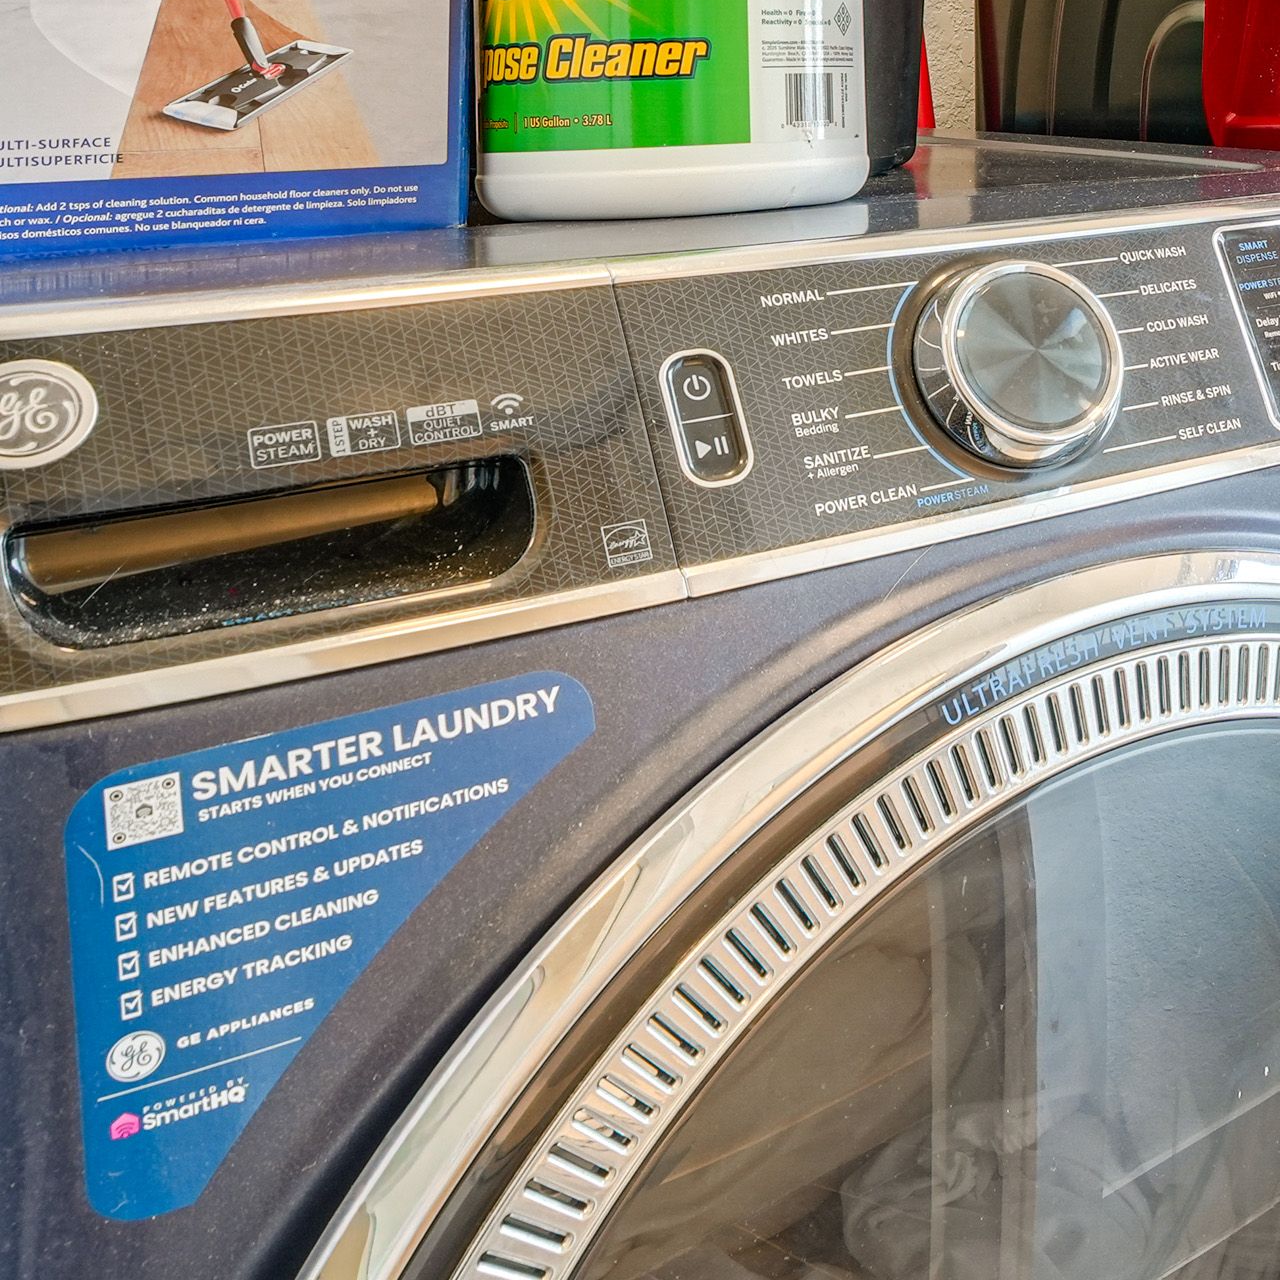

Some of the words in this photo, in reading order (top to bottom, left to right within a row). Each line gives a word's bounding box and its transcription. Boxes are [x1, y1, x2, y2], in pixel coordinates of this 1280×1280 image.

[544, 37, 710, 81] Cleaner
[530, 117, 540, 128] US
[542, 116, 570, 127] Gallon
[582, 115, 604, 126] 3.78
[606, 114, 612, 125] L
[35, 203, 56, 212] Add
[59, 201, 67, 210] 2
[69, 202, 91, 213] tsps
[92, 199, 104, 209] of
[105, 197, 146, 210] cleaning
[149, 196, 191, 206] solution.
[193, 194, 238, 204] Common
[240, 191, 287, 201] household
[289, 189, 310, 199] floor
[312, 188, 349, 198] cleaners
[350, 186, 372, 197] only.
[373, 186, 386, 195] Do
[387, 185, 402, 194] not
[403, 184, 419, 193] use
[1238, 239, 1268, 251] SMART
[1120, 248, 1154, 265] QUICK
[1154, 246, 1186, 261] WASH
[1236, 250, 1279, 265] DISPENSE
[1140, 278, 1197, 296] DELICATES
[760, 288, 825, 308] NORMAL
[1146, 318, 1177, 333] COLD
[1177, 314, 1209, 329] WASH
[1255, 316, 1280, 329] Delay
[770, 328, 829, 348] WHITES
[1150, 353, 1188, 369] ACTIVE
[1188, 348, 1220, 363] WEAR
[782, 369, 843, 390] TOWELS
[1161, 391, 1195, 407] RINSE
[1196, 388, 1206, 401] &
[1206, 384, 1232, 400] SPIN
[425, 403, 457, 419] dBT
[791, 406, 840, 426] BULKY
[349, 414, 393, 431] WASH
[423, 416, 463, 431] QUIET
[490, 416, 534, 431] SMART
[795, 421, 839, 438] Bedding
[1178, 423, 1206, 441] SELF
[1206, 418, 1242, 436] CLEAN
[253, 429, 313, 447] POWER
[358, 436, 387, 451] DRY
[414, 425, 479, 444] CONTROL
[256, 442, 314, 463] STEAM
[803, 445, 871, 470] SANITIZE
[816, 462, 859, 480] Allergen
[814, 497, 868, 517] POWER
[870, 483, 918, 506] CLEAN
[942, 638, 1100, 726] ULTRAFRESH
[1112, 620, 1171, 651] VENT
[1186, 607, 1267, 633] SYSTEM
[191, 732, 384, 801] SMARTER
[392, 685, 561, 752] LAUNDRY
[198, 795, 263, 822] STARTS
[265, 781, 316, 806] WHEN
[318, 771, 353, 793] YOU
[356, 751, 433, 783] CONNECT
[143, 850, 233, 889] REMOTE
[237, 827, 339, 864] CONTROL
[342, 819, 359, 836] &
[362, 777, 510, 831] NOTIFICATIONS
[146, 900, 198, 929] NEW
[203, 871, 309, 914] FEATURES
[312, 865, 330, 882] &
[333, 839, 424, 877] UPDATES
[148, 922, 271, 969] ENHANCED
[274, 889, 380, 932] CLEANING
[150, 968, 238, 1008] ENERGY
[242, 934, 353, 974] TRACKING
[176, 1031, 201, 1049] GE
[206, 997, 315, 1041] APPLIANCES
[142, 1085, 217, 1114] POWERED
[226, 1076, 244, 1088] BY
[142, 1085, 247, 1131] SmartHQ
